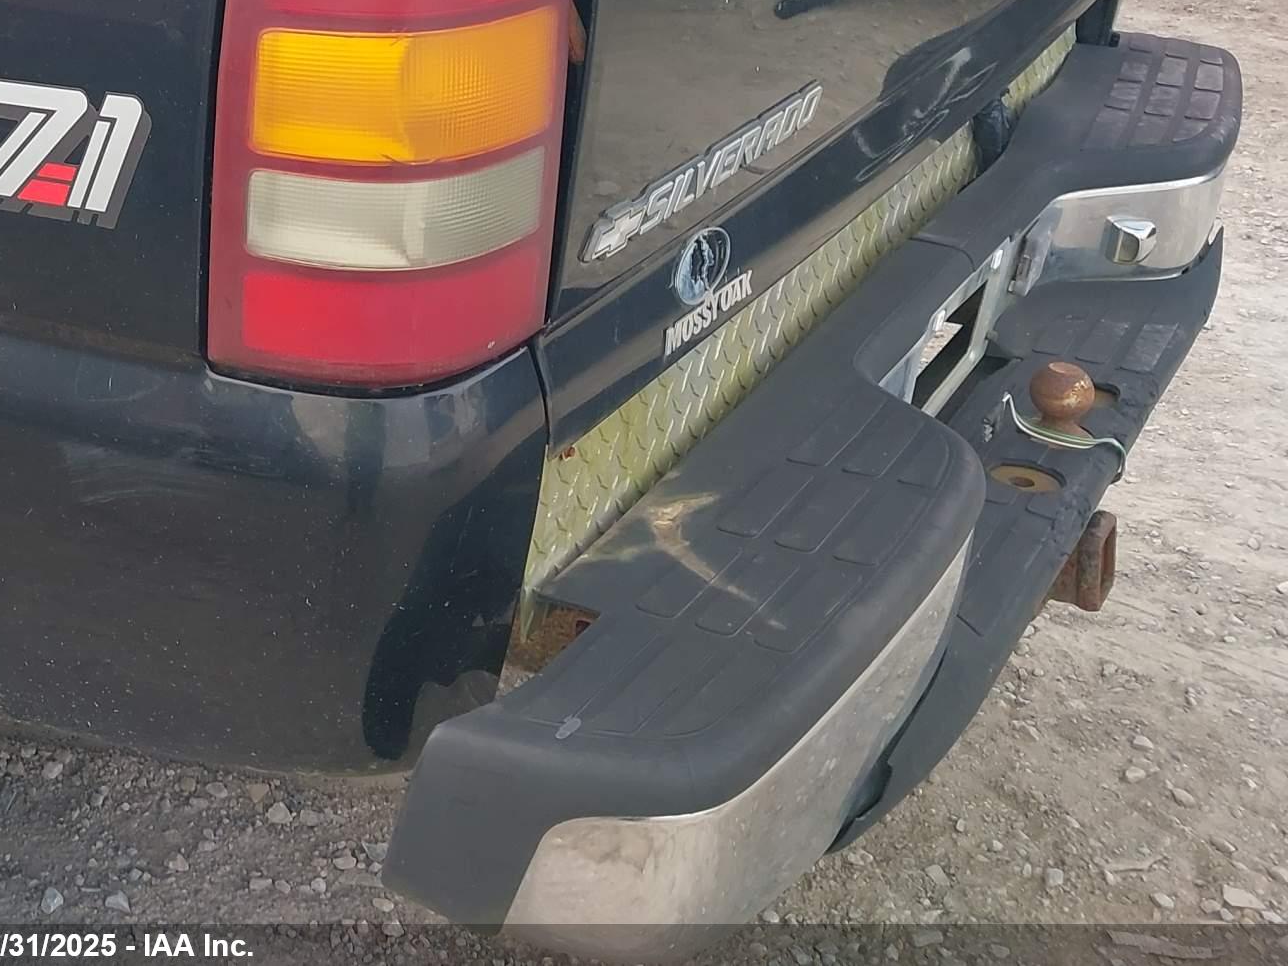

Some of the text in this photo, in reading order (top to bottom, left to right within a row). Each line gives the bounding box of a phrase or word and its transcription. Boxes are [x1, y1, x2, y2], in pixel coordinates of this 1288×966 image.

[639, 85, 823, 236] SILVERADO
[664, 269, 753, 356] MOSSY OAK
